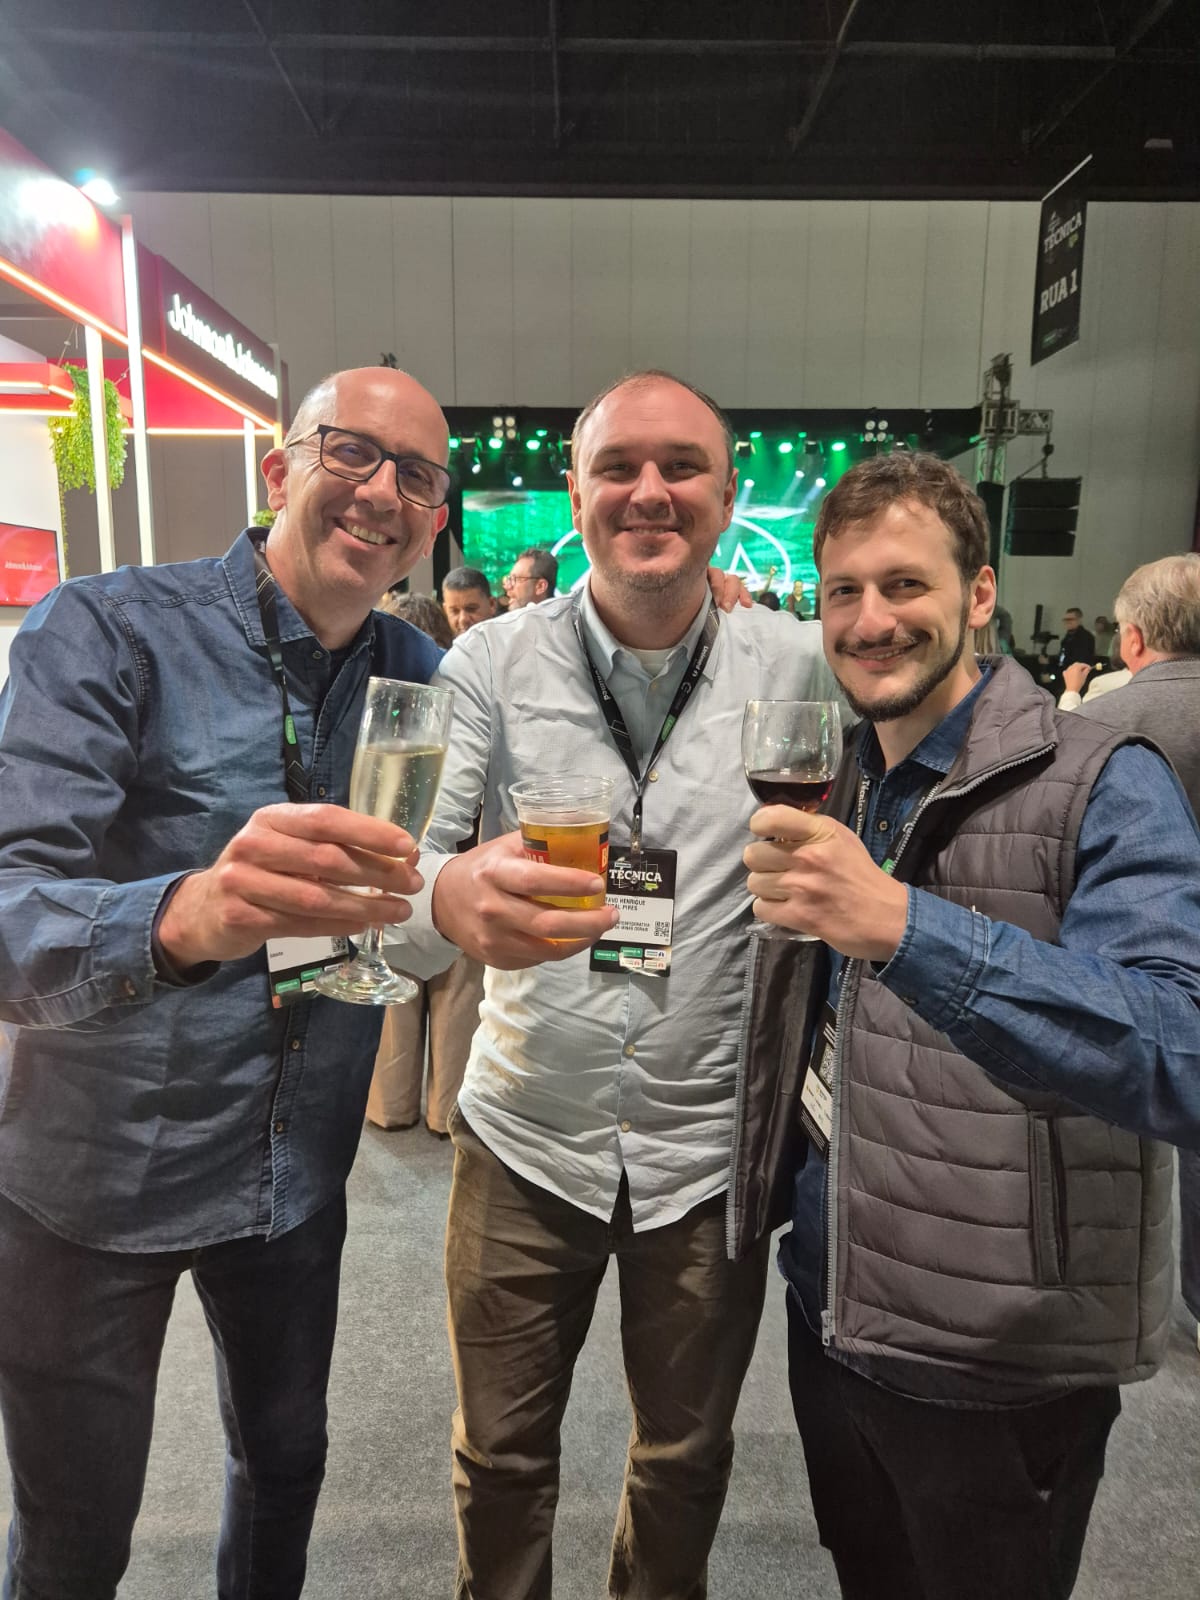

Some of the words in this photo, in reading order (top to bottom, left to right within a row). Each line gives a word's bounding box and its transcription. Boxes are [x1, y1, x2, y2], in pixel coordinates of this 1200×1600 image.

[1039, 276, 1068, 314] RUA
[1069, 268, 1078, 295] 1
[608, 867, 663, 883] TÉCNICA
